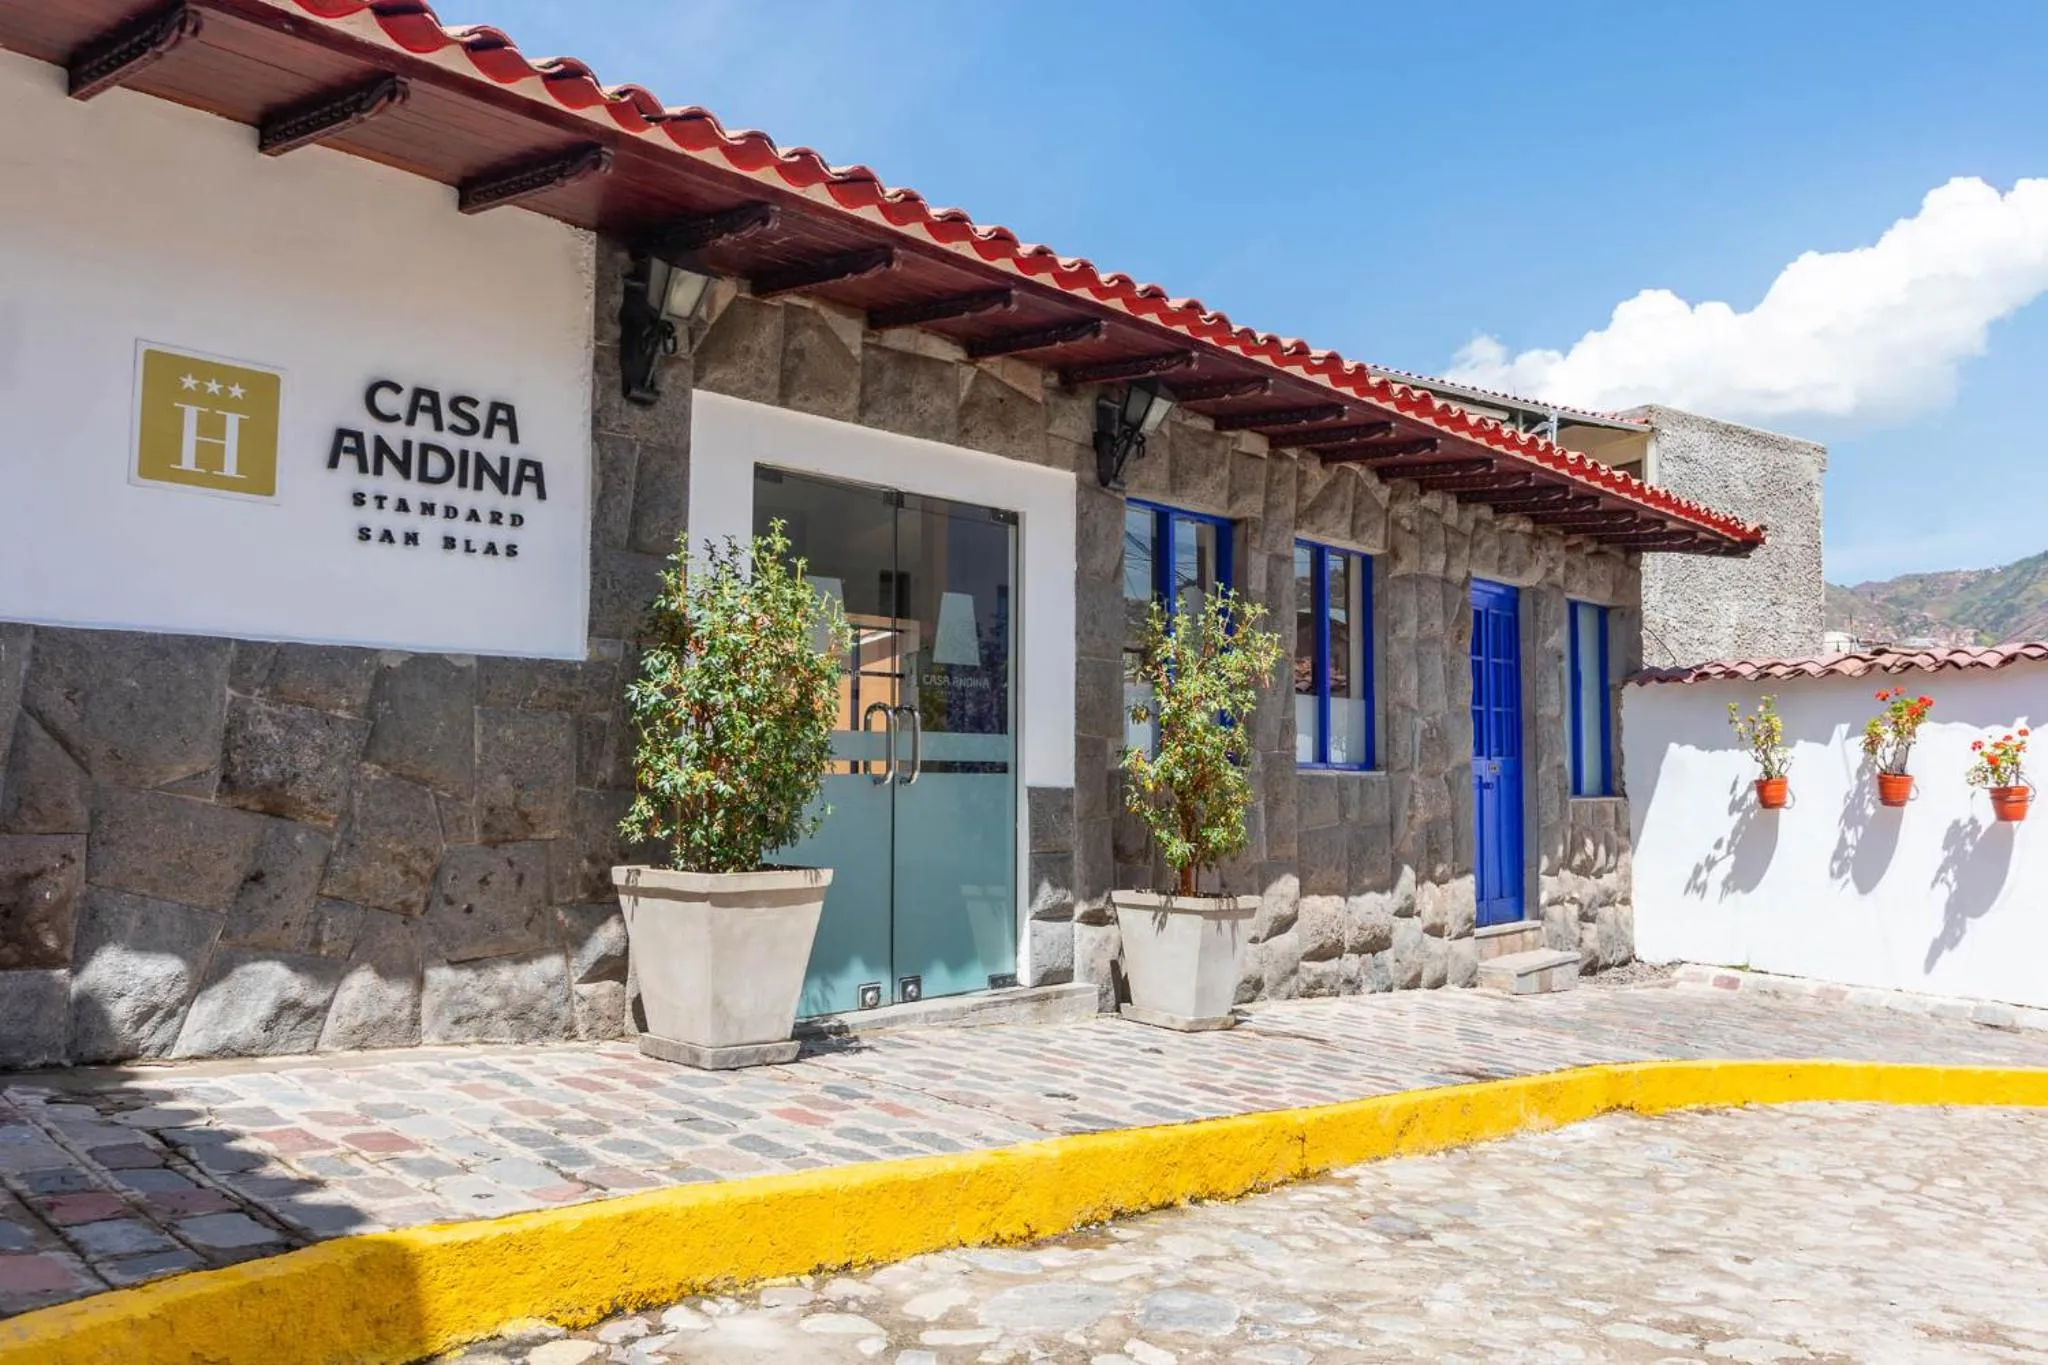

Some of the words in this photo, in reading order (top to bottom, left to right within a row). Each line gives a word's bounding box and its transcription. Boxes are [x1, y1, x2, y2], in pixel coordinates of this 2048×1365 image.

[365, 380, 519, 444] CASA
[169, 402, 250, 479] H
[327, 428, 547, 500] ANDINA
[352, 492, 525, 527] STANDARD
[358, 527, 419, 546] SAN
[442, 535, 518, 557] BLAS
[922, 674, 950, 686] CASA
[952, 676, 990, 689] ANDINA
